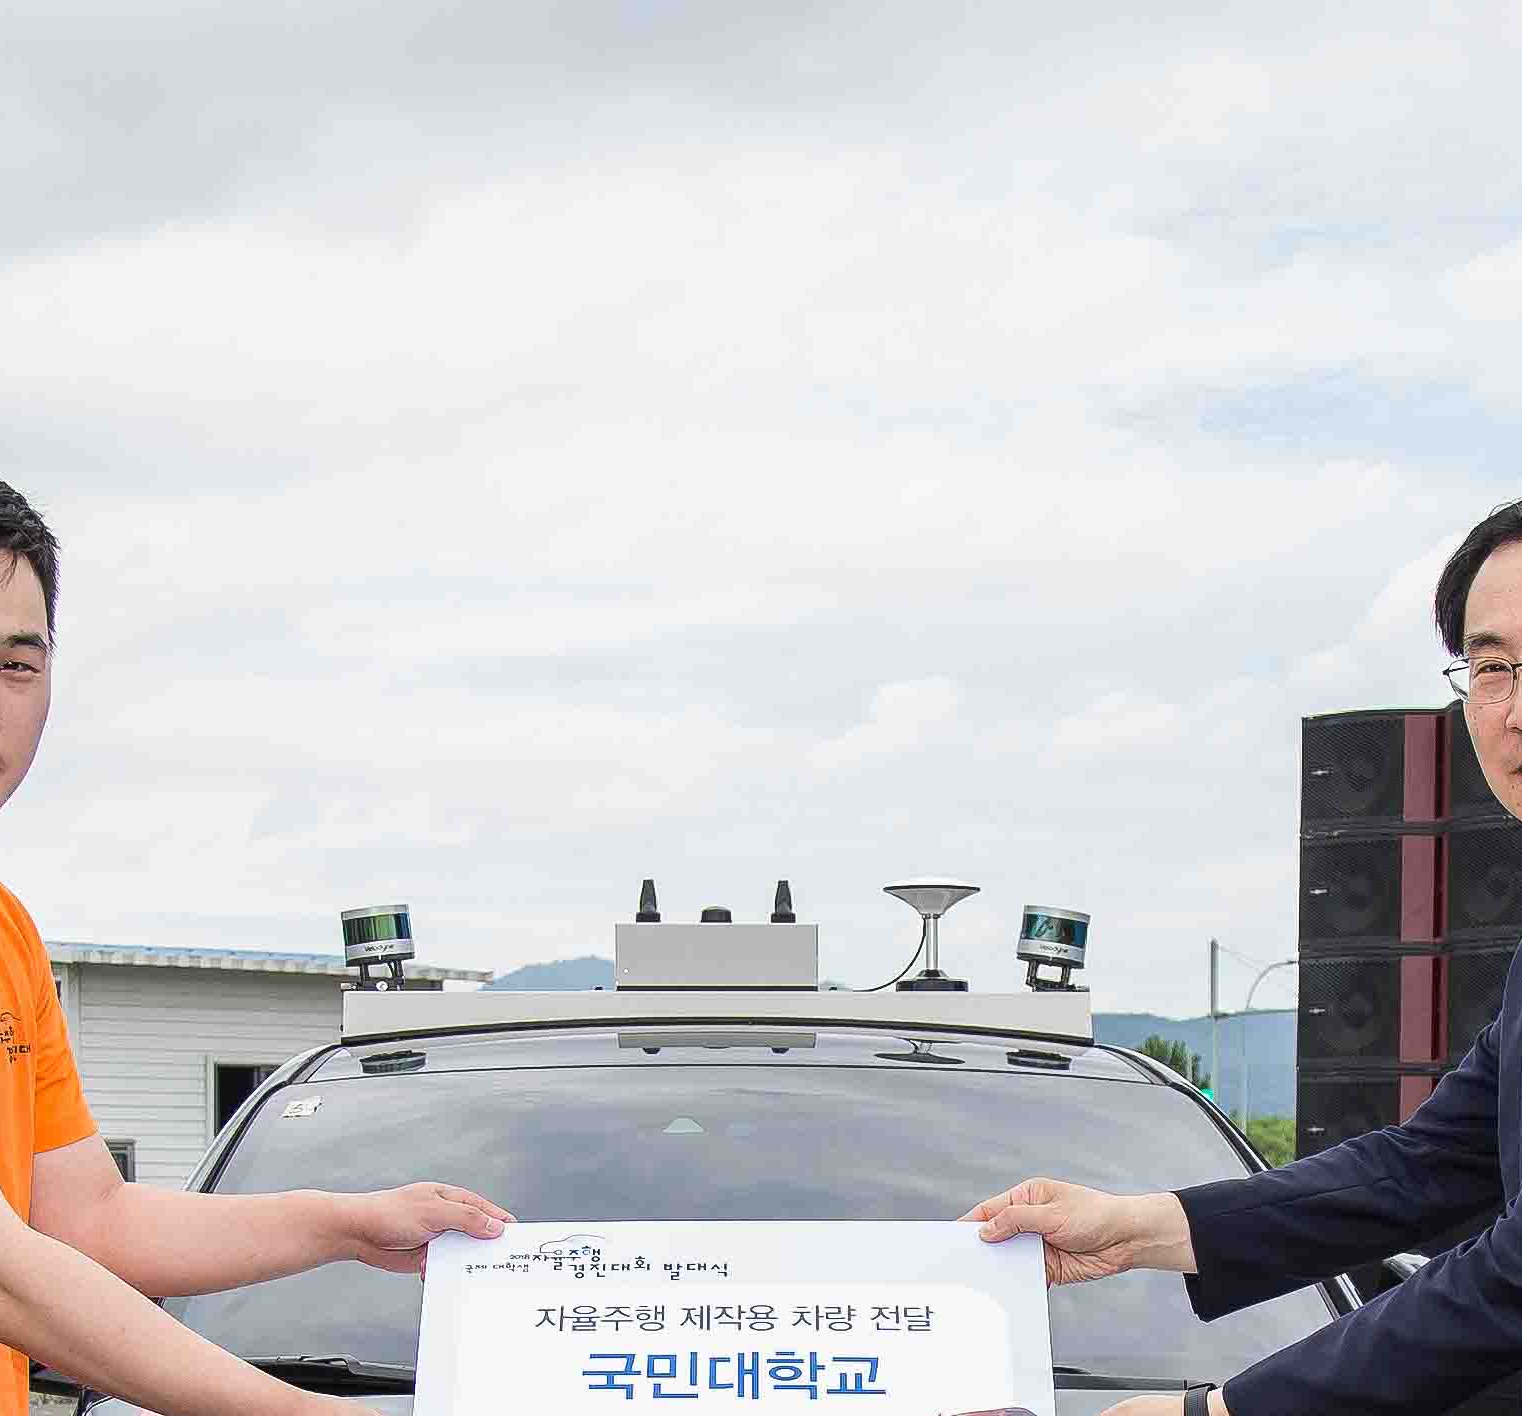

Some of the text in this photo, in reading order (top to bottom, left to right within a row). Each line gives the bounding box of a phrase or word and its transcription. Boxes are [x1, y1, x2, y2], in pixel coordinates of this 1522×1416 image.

[532, 1245, 602, 1272] 자율주행
[567, 1256, 651, 1280] 경진대회
[663, 1263, 728, 1281] 발대식
[535, 1304, 934, 1332] 자율주행 제작용 차량 전달
[581, 1351, 887, 1400] 국민대학교
